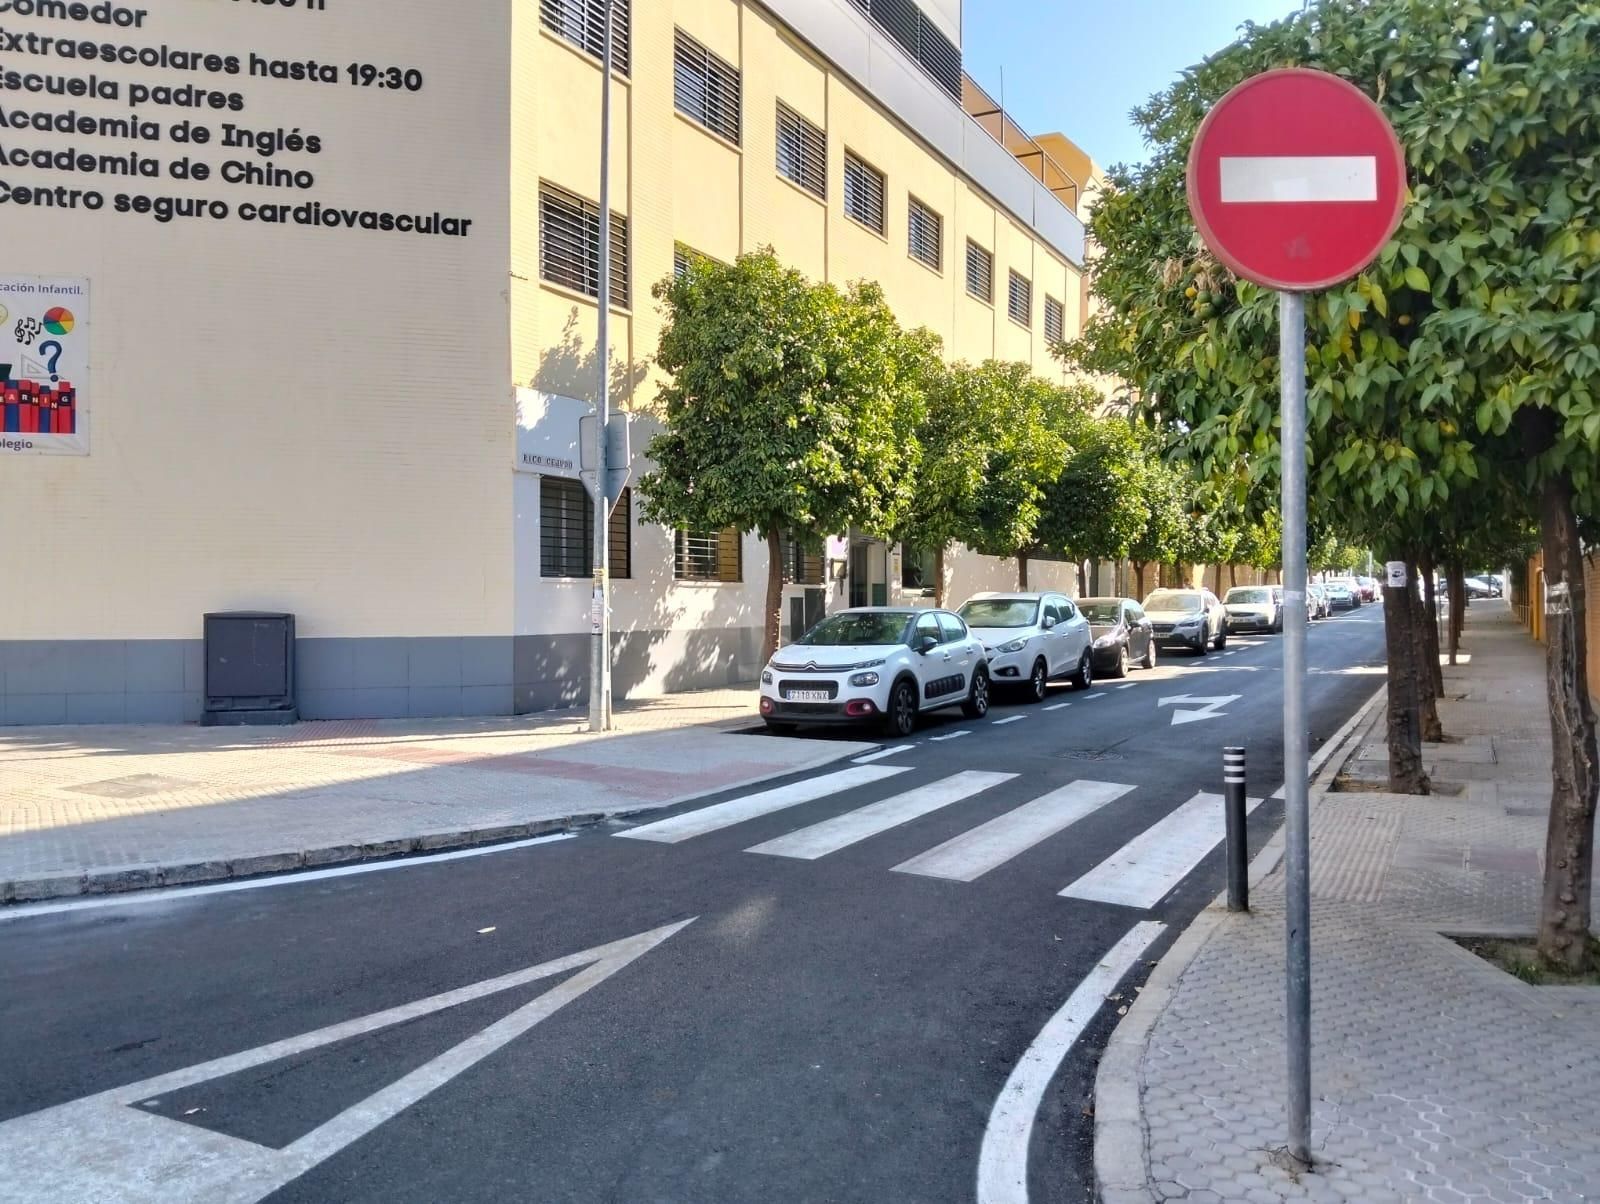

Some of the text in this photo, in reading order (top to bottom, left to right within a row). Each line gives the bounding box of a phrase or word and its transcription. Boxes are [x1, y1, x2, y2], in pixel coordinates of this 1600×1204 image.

[0, 27, 423, 92] xtraescolares hasta 19:30
[0, 65, 244, 112] scuela padres
[169, 119, 211, 145] de
[221, 123, 322, 157] Inglés
[168, 156, 211, 182] de
[220, 160, 315, 190] Chino
[113, 193, 229, 223] seguro
[237, 201, 473, 237] cardiovascular
[38, 284, 83, 295] Infantil.
[0, 438, 33, 452] legio
